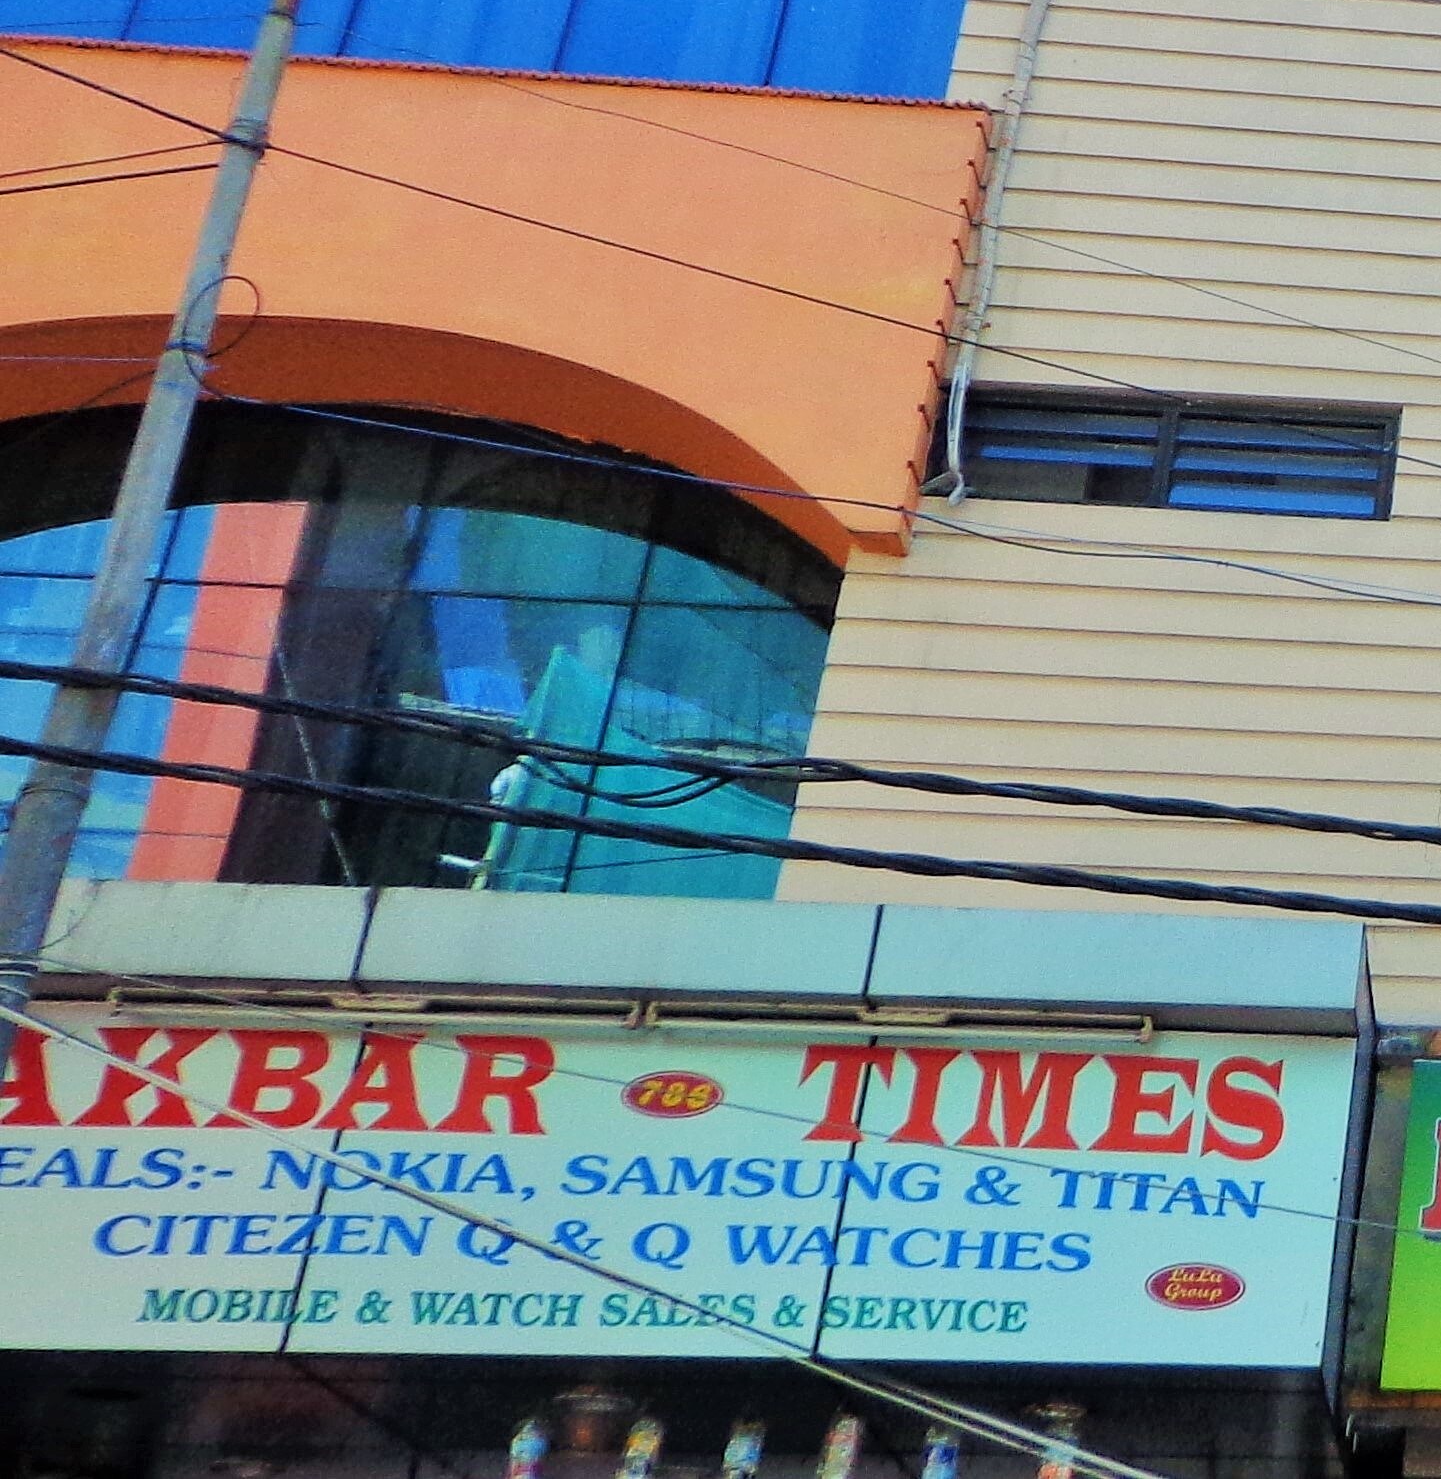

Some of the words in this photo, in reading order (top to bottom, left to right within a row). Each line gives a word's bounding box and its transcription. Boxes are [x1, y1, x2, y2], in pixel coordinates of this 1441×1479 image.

[798, 1044, 1286, 1162] TIMES
[259, 1148, 535, 1202] NOKIA,
[561, 1154, 943, 1205] SAMSUNG
[963, 1164, 1021, 1209] &
[1050, 1167, 1266, 1220] TITAN
[94, 1214, 433, 1260] CITEZEN
[456, 1217, 516, 1265] Q
[550, 1219, 604, 1261] &
[631, 1222, 691, 1270] Q
[726, 1224, 1093, 1274] WATCHES
[137, 1287, 338, 1324] MOBILE
[354, 1289, 394, 1324] &
[410, 1291, 582, 1327] WATCH
[599, 1293, 757, 1328] SALES
[771, 1296, 805, 1329] &
[819, 1296, 1030, 1334] SERVICE
[1164, 1282, 1222, 1302] Group
